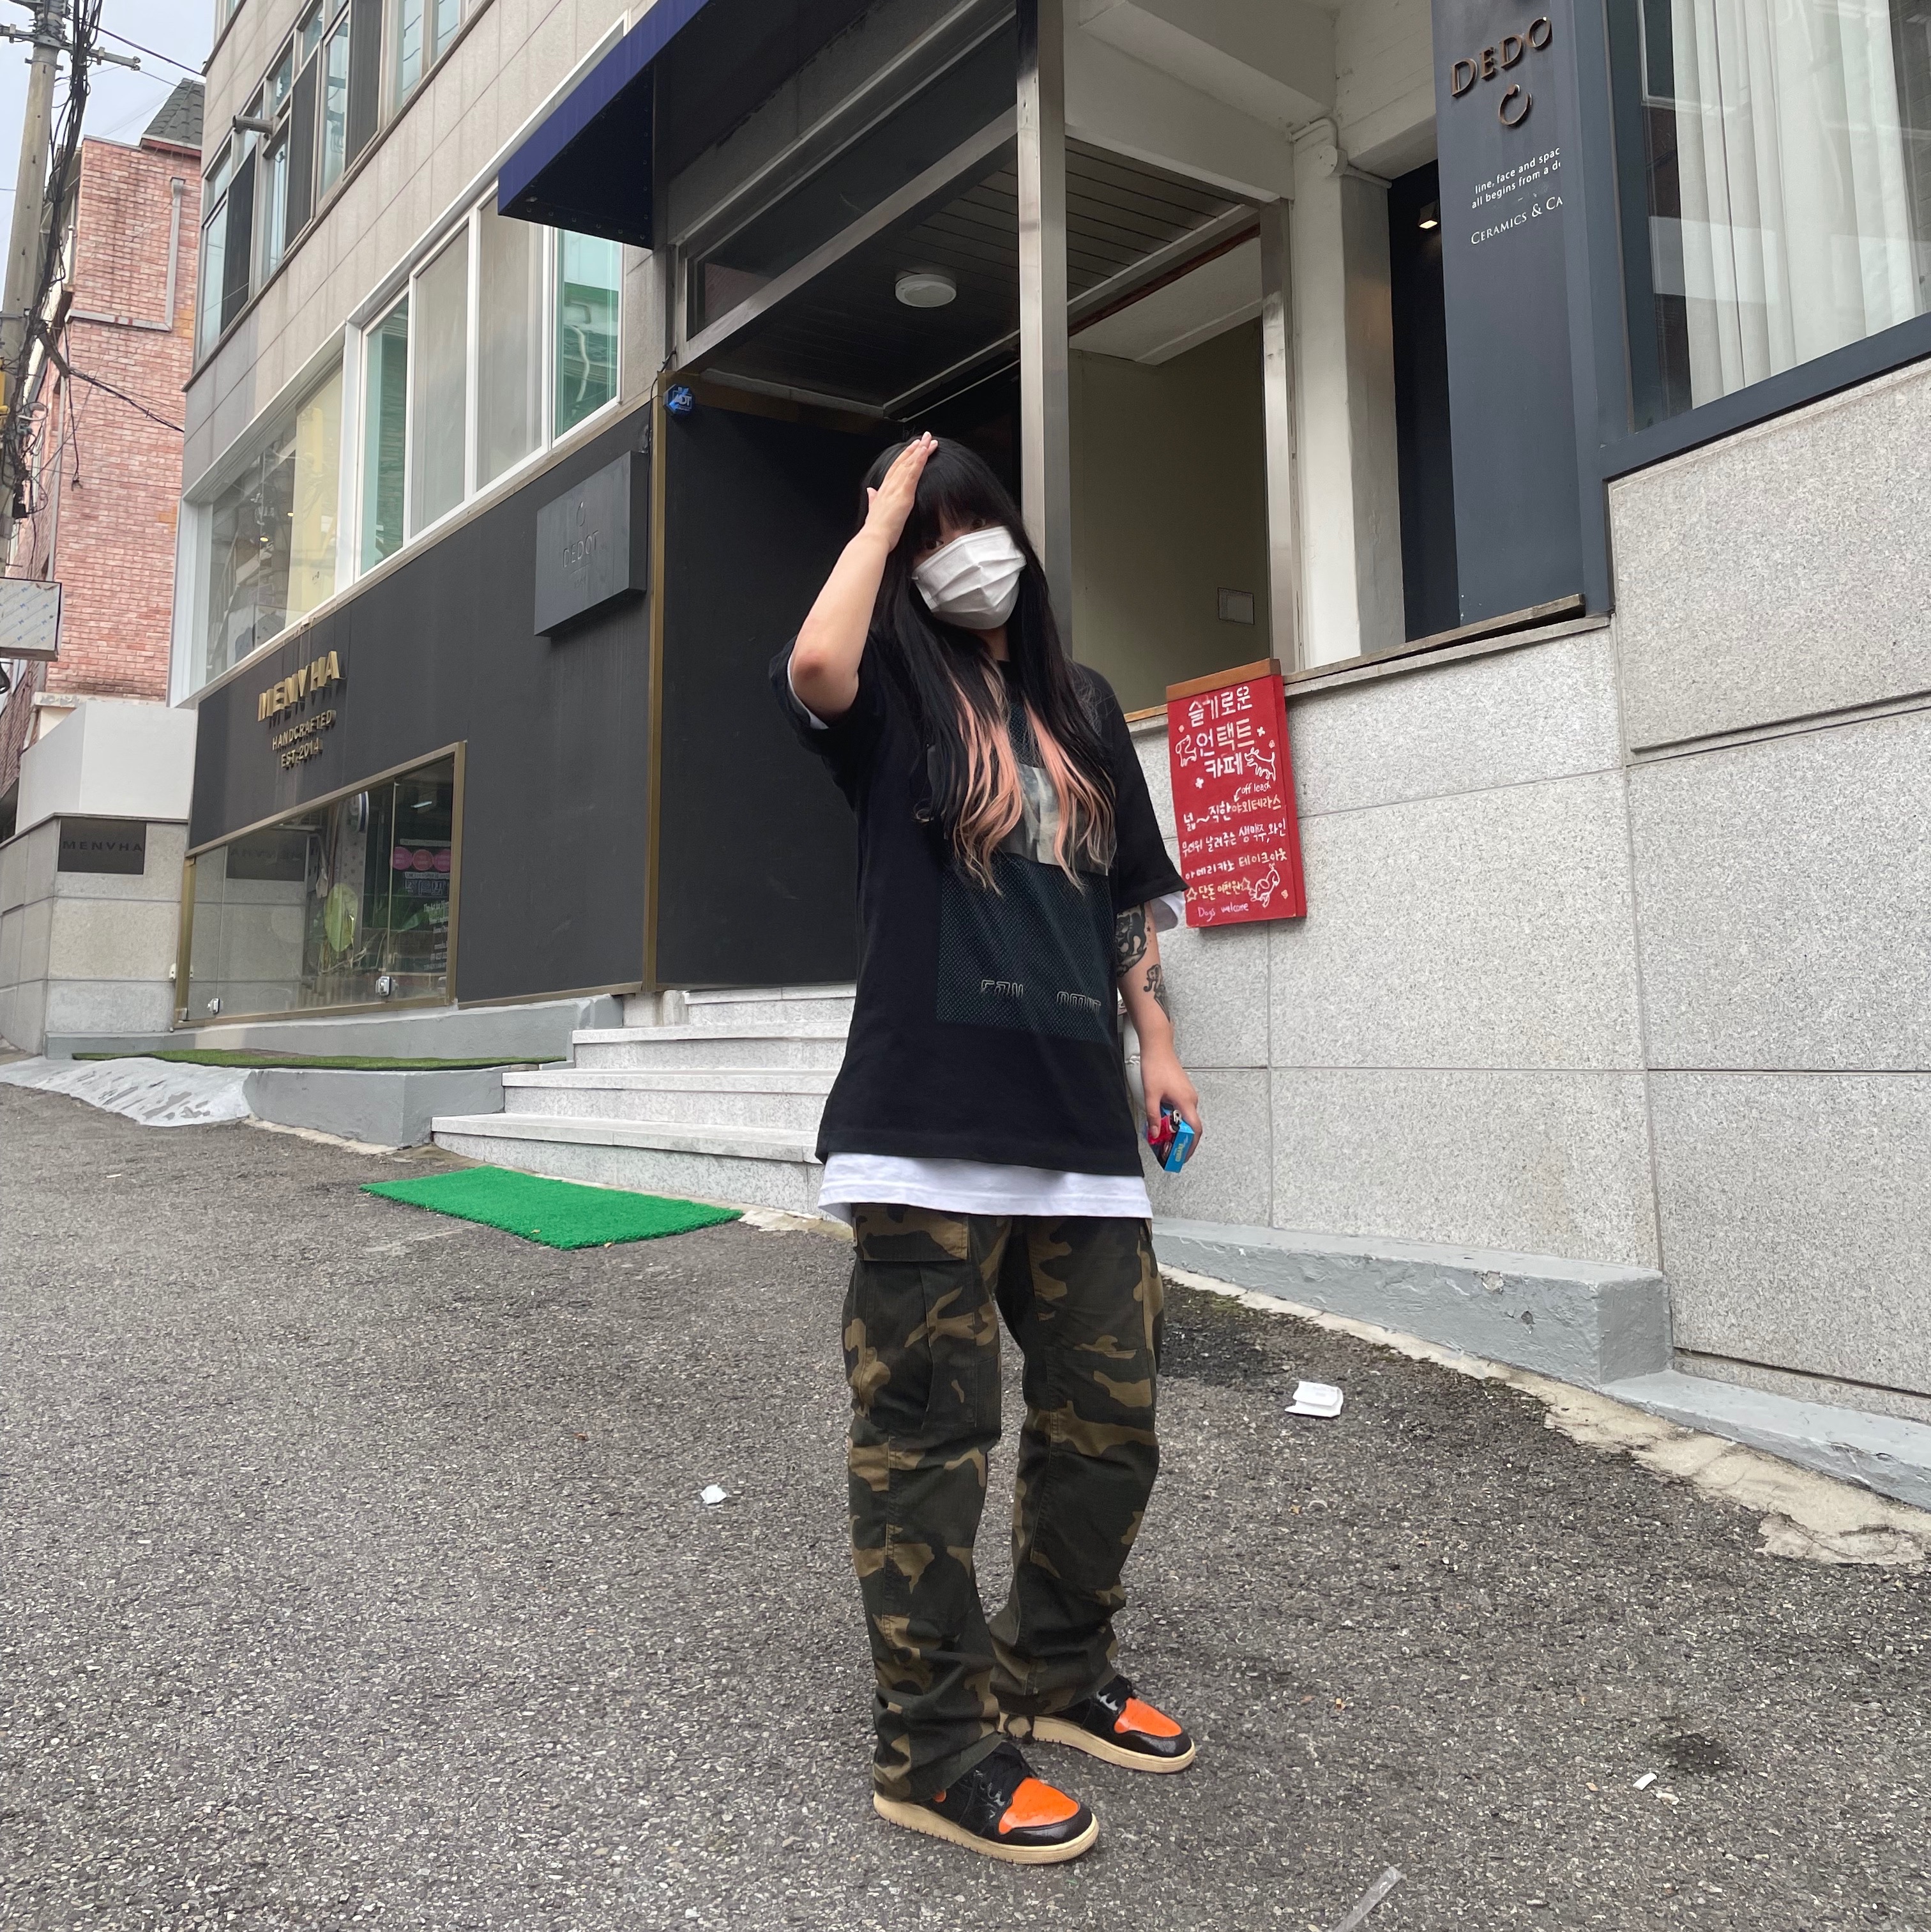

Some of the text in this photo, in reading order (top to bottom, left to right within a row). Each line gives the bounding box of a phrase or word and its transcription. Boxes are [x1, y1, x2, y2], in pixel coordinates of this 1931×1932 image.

[1471, 196, 1483, 209] all
[1485, 183, 1517, 202] begins
[1518, 172, 1540, 187] from
[1552, 160, 1561, 171] d
[1475, 181, 1495, 194] line,
[1497, 169, 1516, 184] face
[1518, 158, 1536, 174] and
[1471, 211, 1527, 245] CERAMICS
[1531, 203, 1542, 217] &
[563, 529, 599, 568] DEDOT
[257, 651, 340, 722] MENVHA
[1188, 686, 1253, 727] 슬기로운
[272, 710, 337, 750] HANDCRAFTED
[1196, 719, 1255, 757] 언택트
[1204, 752, 1243, 779] 카페
[1241, 781, 1271, 794] off leash
[63, 840, 142, 852] MENVHA
[1205, 832, 1237, 853] 날려주는
[1268, 818, 1286, 837] 와인
[1185, 848, 1287, 879] 아메리카노 테이크아웃
[1199, 881, 1241, 901] 단돈 이천원
[1198, 902, 1249, 922] Dogs welcome
